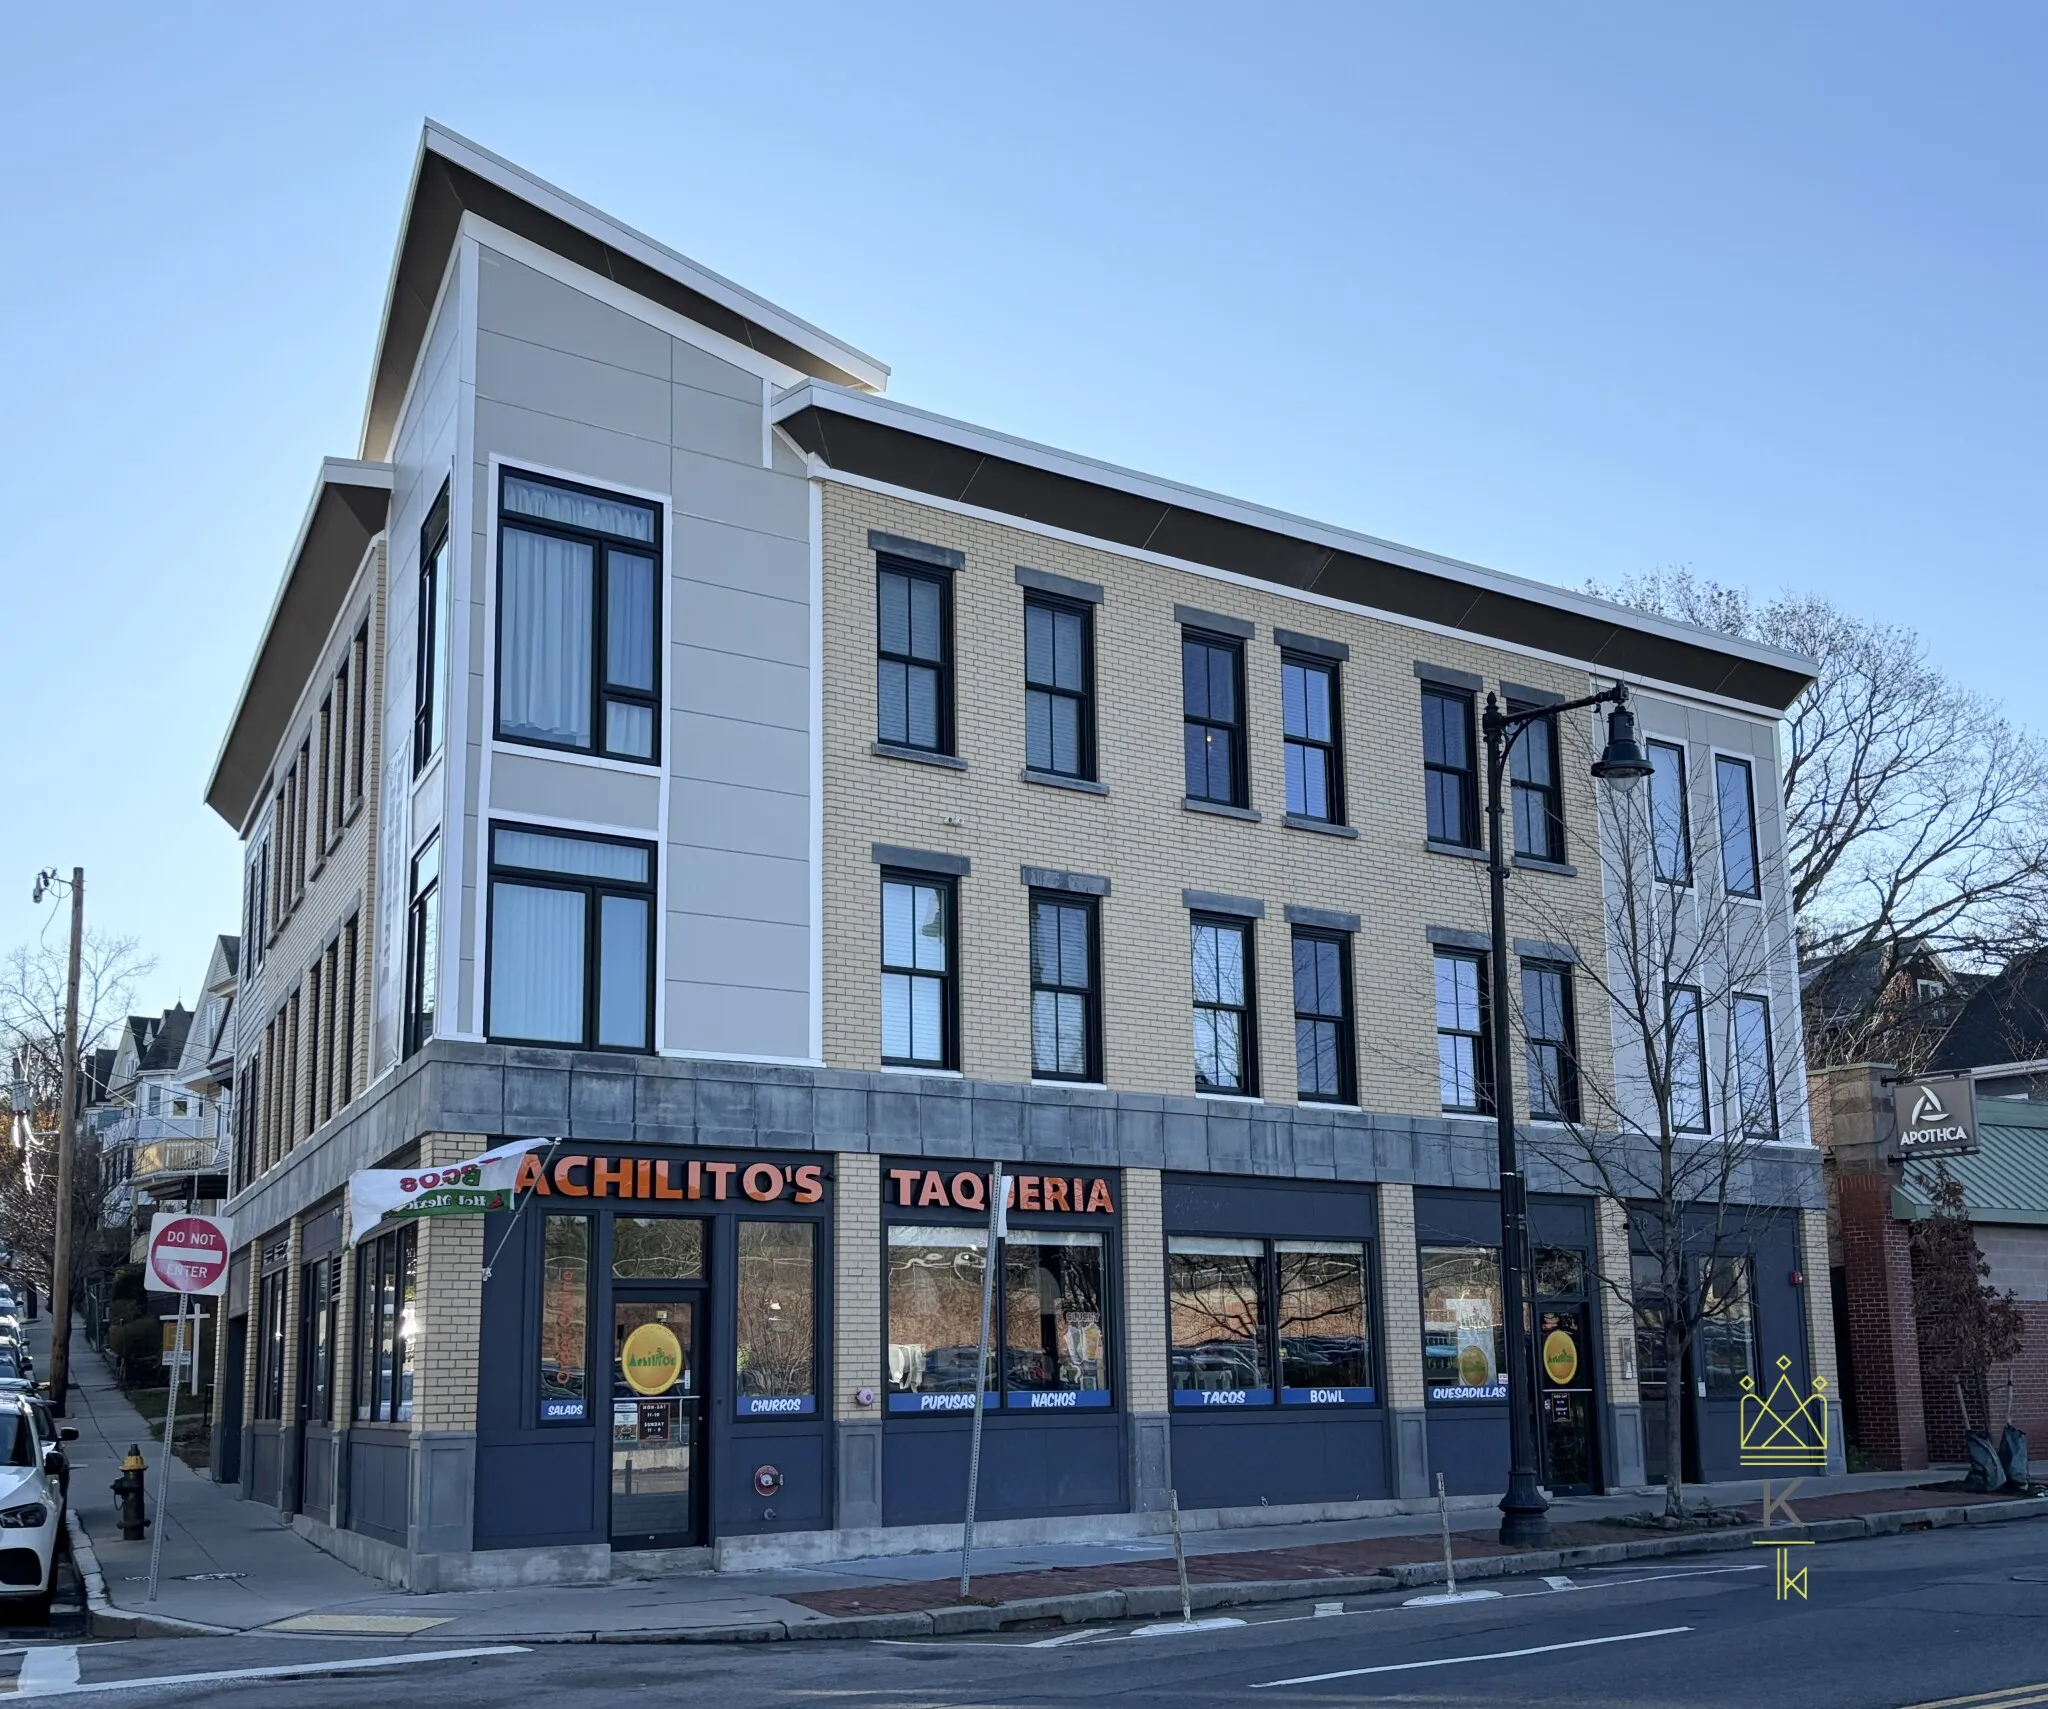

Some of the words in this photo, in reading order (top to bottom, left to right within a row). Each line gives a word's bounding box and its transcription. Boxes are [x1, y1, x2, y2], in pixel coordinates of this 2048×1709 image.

[1900, 1126, 1968, 1146] APOTHCA
[513, 1153, 824, 1203] ACHILITO'S
[167, 1230, 185, 1243] DO
[190, 1232, 216, 1246] NOT
[166, 1263, 208, 1279] ENTER
[1031, 1391, 1077, 1407] NACHOS
[1201, 1390, 1246, 1404] TACOS
[1310, 1389, 1345, 1403] BOWL
[1433, 1386, 1507, 1399] QUESADILLAS
[750, 1398, 801, 1412] CHURROS
[921, 1393, 976, 1410] PUPUSAS
[547, 1404, 584, 1416] SALADS
